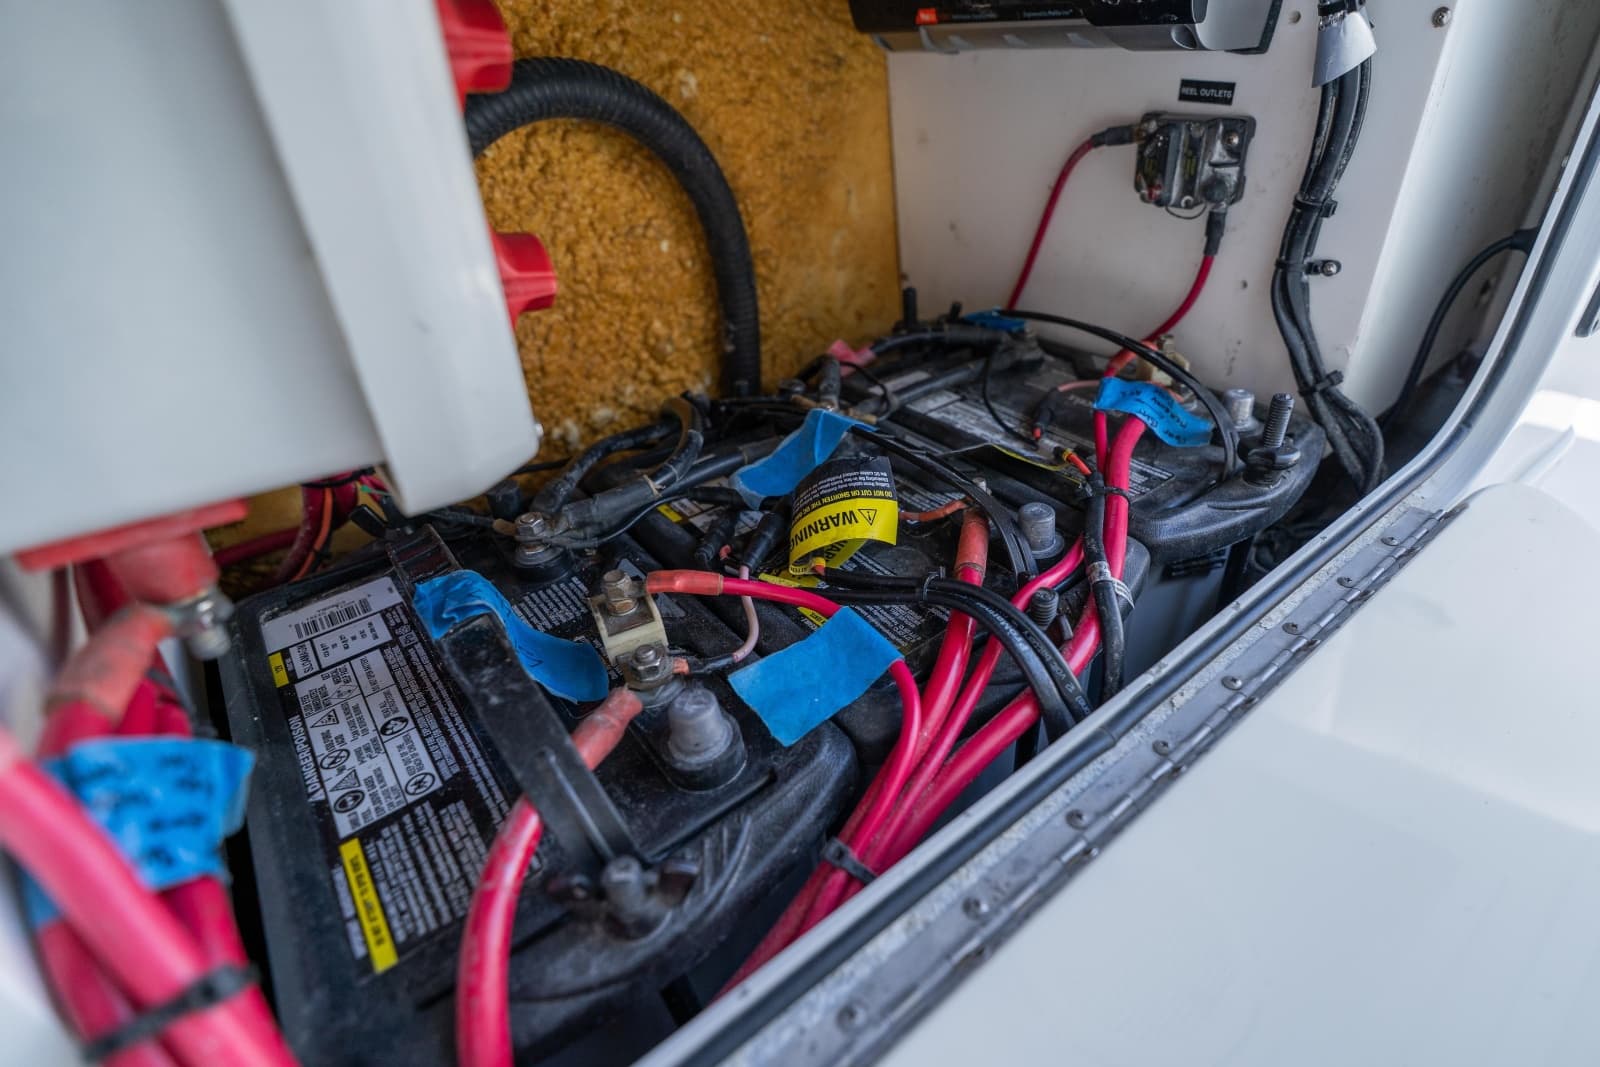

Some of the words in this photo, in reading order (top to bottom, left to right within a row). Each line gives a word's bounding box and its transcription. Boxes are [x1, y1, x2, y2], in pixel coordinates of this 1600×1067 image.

[1200, 88, 1232, 98] OUTLETS
[822, 490, 851, 505] SHORTEN
[286, 713, 321, 793] DANGER/POISON
